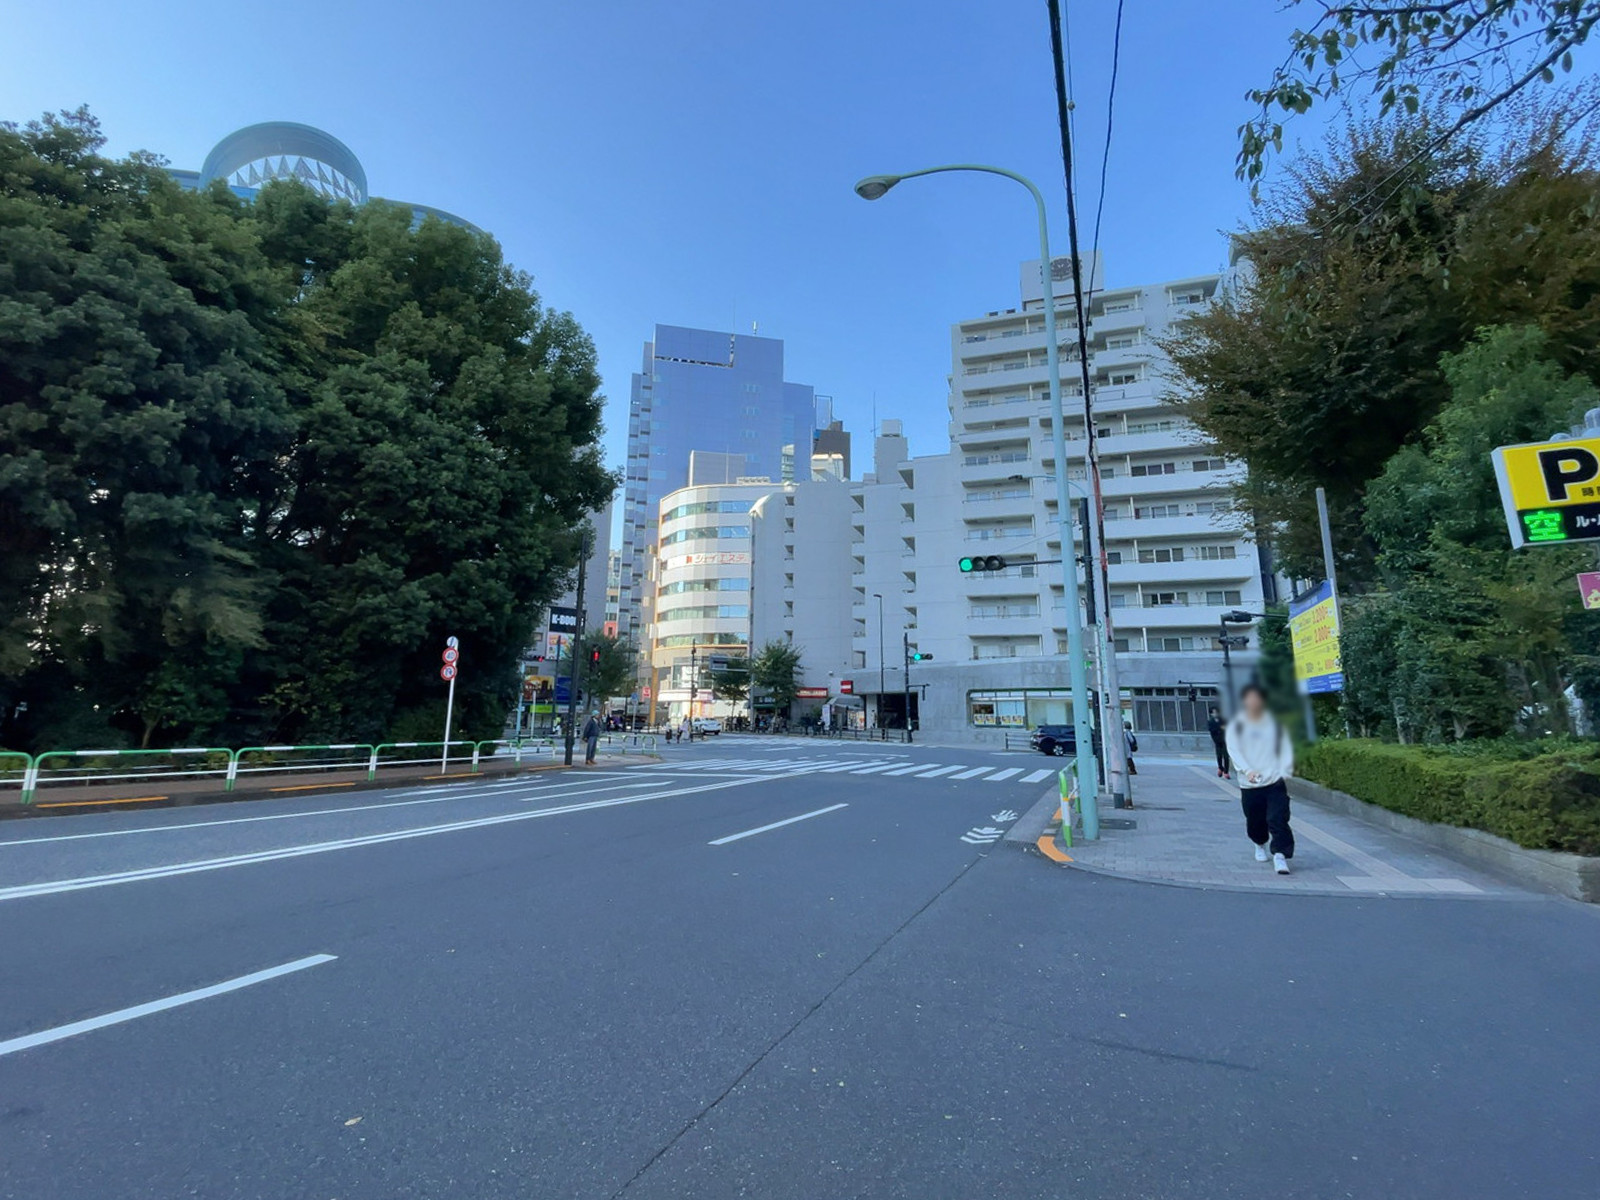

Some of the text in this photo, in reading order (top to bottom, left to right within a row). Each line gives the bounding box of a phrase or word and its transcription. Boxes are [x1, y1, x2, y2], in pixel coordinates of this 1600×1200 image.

[1537, 448, 1599, 501] P
[1581, 485, 1600, 496] 時
[1524, 511, 1566, 541] 空
[1576, 514, 1600, 527] ル・
